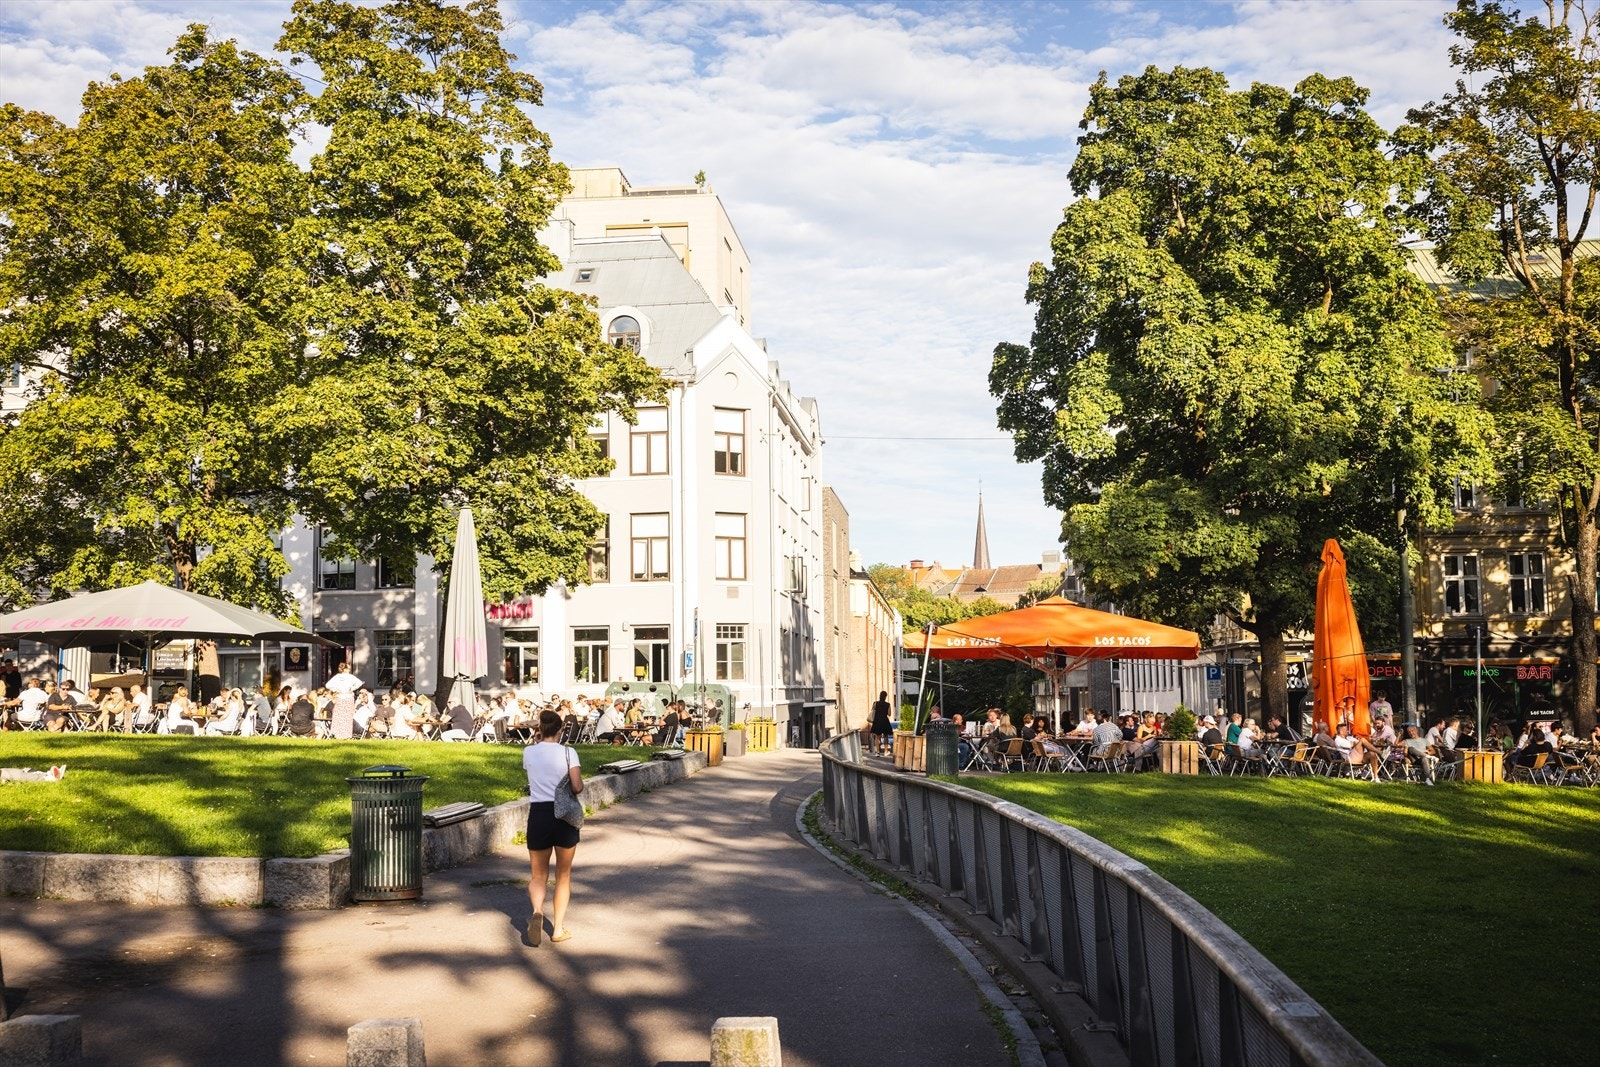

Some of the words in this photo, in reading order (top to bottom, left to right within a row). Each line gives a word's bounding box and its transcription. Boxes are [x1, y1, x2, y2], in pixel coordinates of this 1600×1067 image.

[12, 616, 95, 630] Colel
[946, 637, 967, 647] LOS
[969, 637, 1002, 647] TACOS
[1095, 636, 1115, 646] LOS
[1117, 636, 1151, 646] TACOS
[1209, 667, 1218, 679] P
[1367, 666, 1402, 677] OPEN
[1516, 665, 1552, 680] BAR
